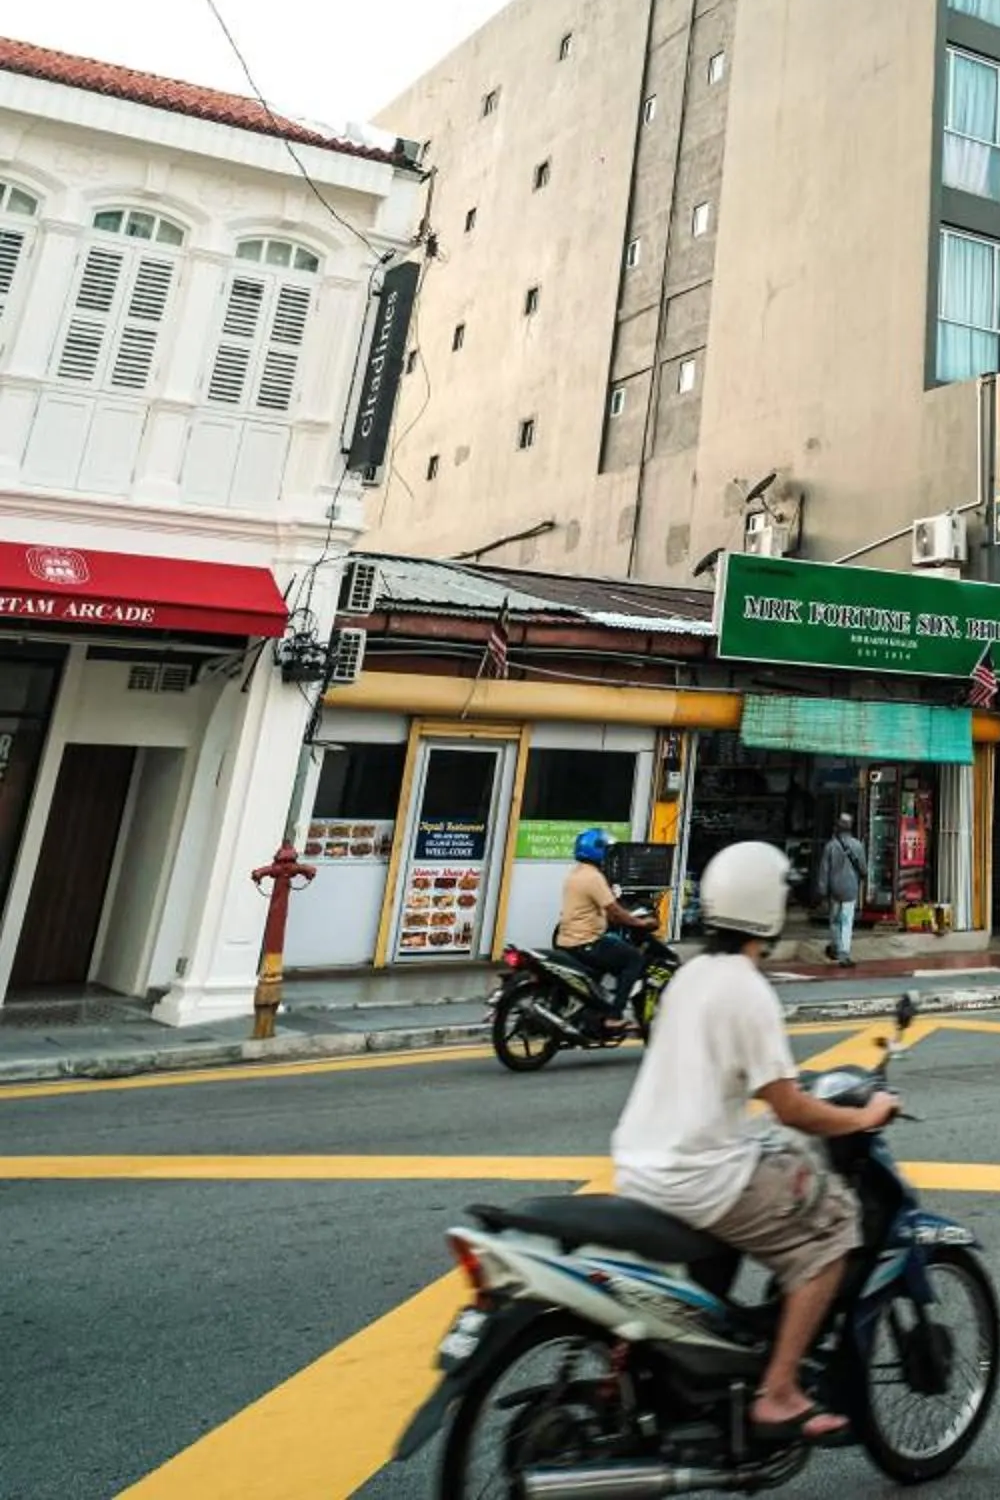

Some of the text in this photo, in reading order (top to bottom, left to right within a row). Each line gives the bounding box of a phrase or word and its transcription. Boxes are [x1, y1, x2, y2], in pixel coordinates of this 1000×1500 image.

[0, 597, 156, 623] TAM ARCADE
[744, 596, 802, 623] MRK
[808, 601, 911, 634] FORTUNE
[916, 614, 961, 639] SDN.
